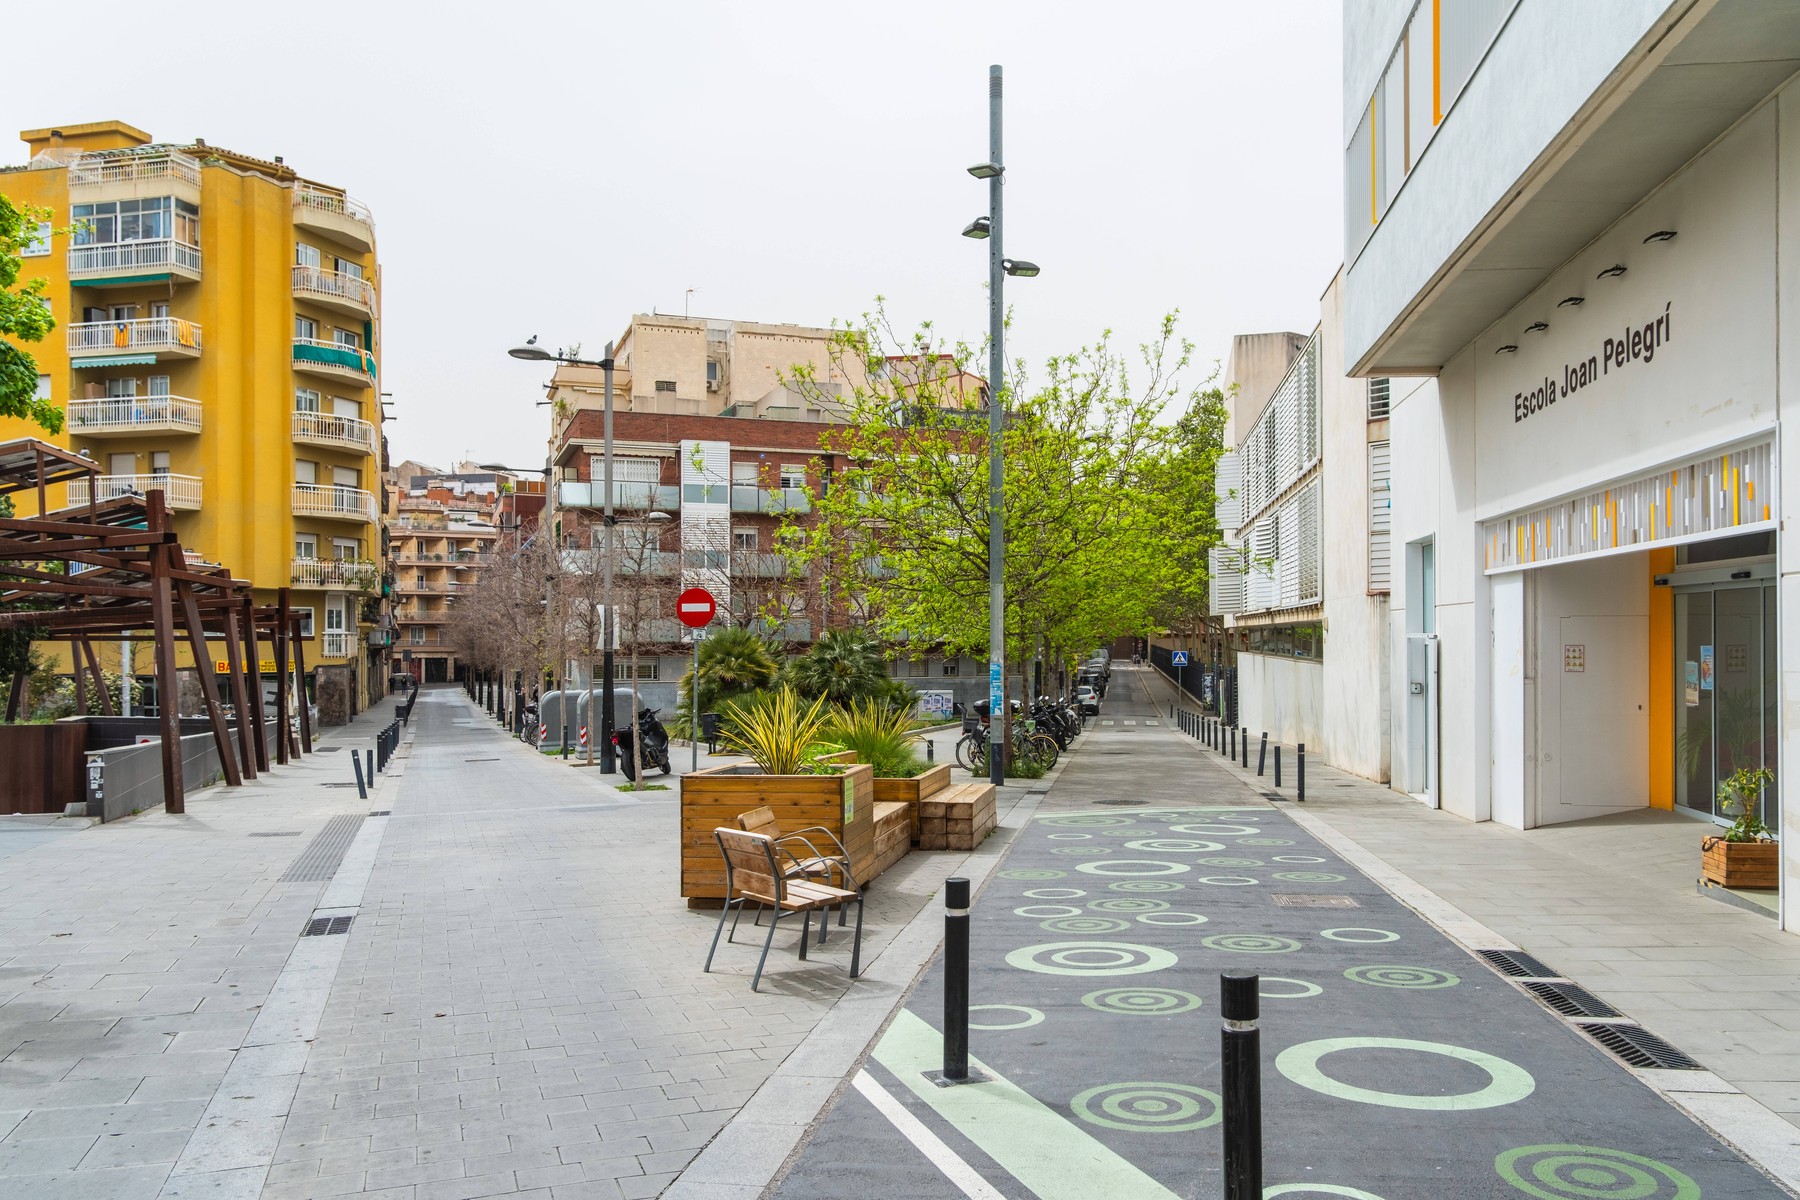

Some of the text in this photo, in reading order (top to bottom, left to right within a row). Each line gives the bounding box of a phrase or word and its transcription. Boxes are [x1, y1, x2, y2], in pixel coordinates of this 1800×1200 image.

[1515, 301, 1672, 423] Escola Joan Pelegrí
[218, 662, 231, 671] BA
